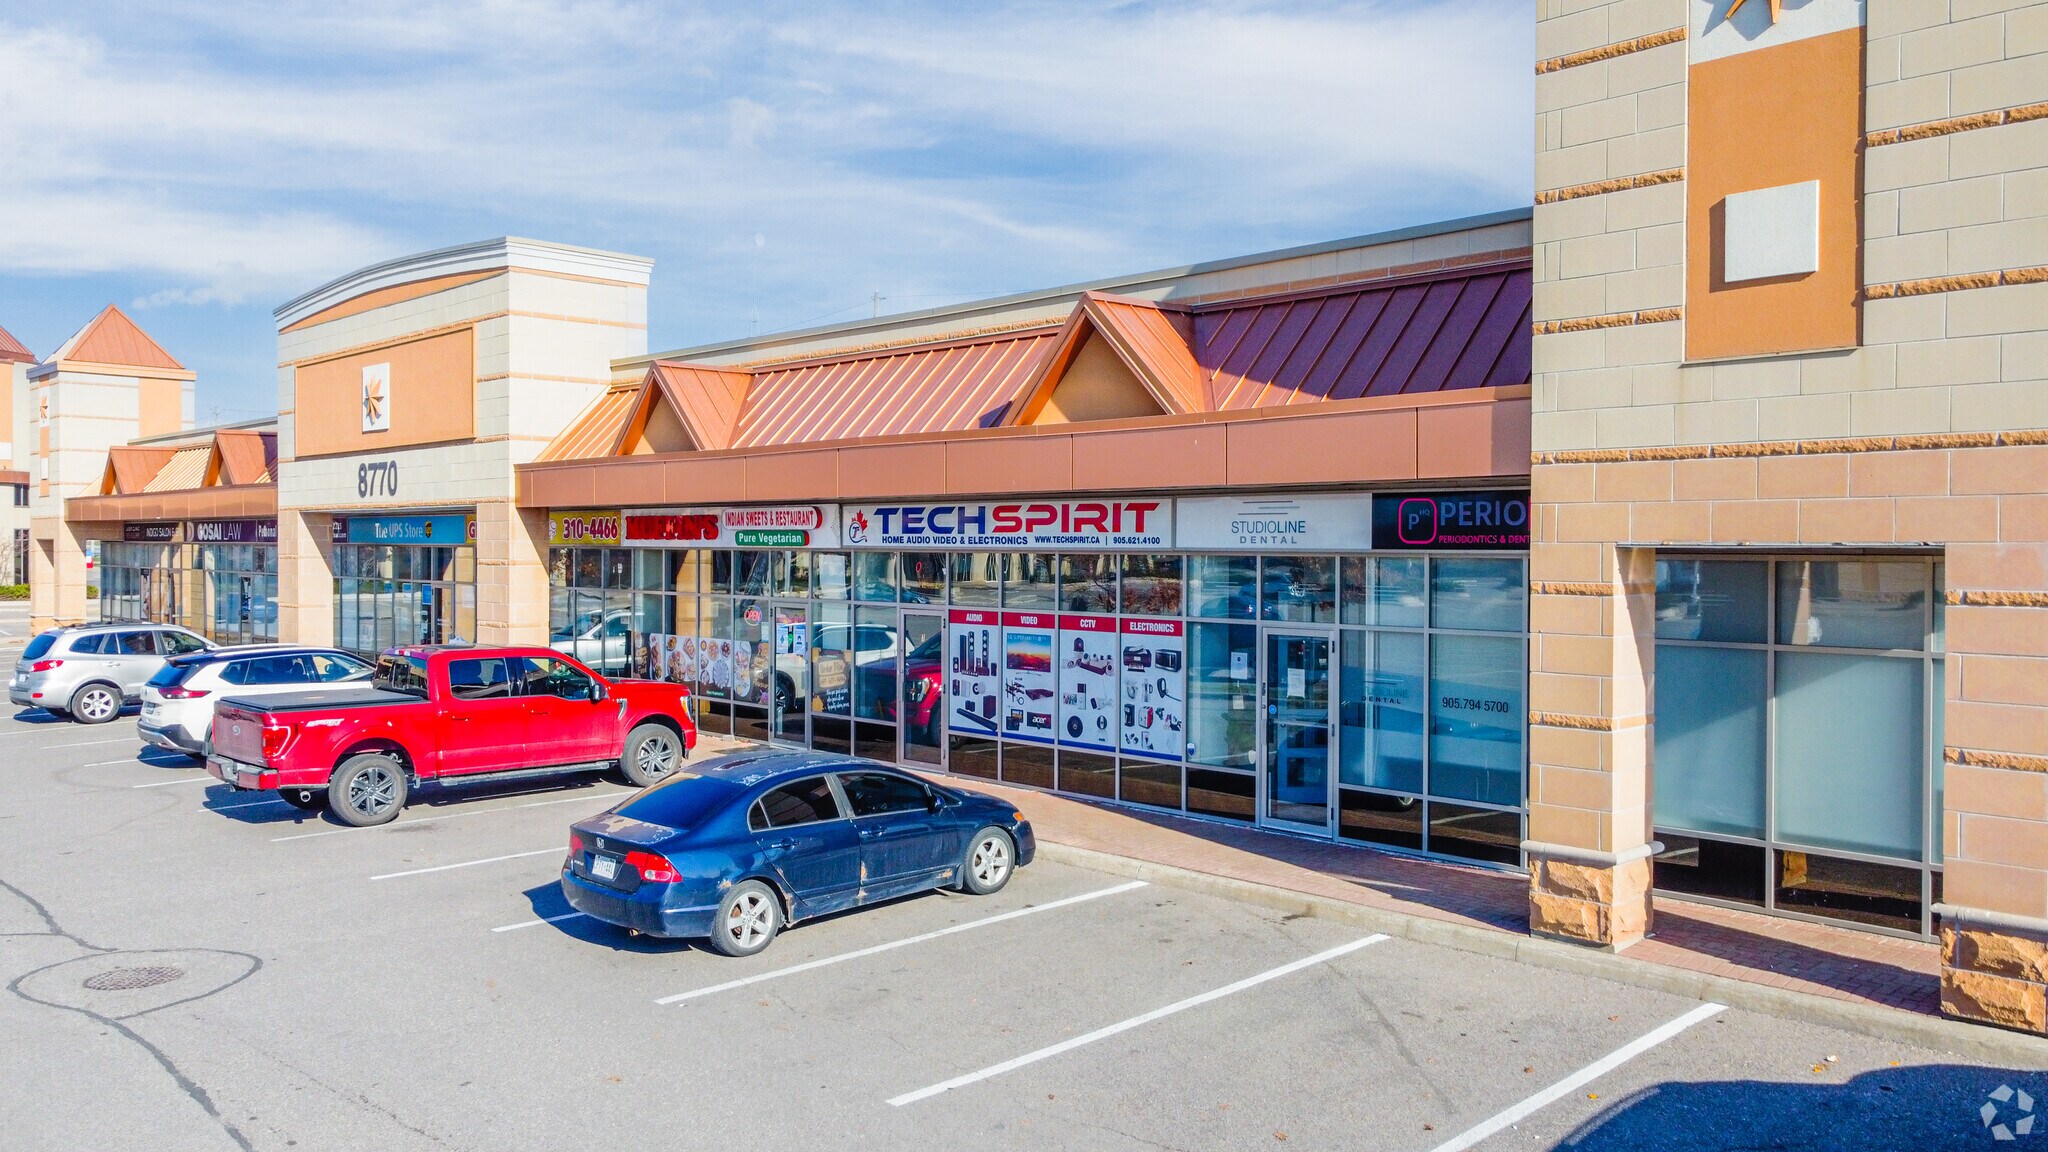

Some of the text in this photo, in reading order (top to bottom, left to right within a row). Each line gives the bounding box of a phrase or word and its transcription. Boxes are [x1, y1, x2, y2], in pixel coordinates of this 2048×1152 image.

[358, 460, 398, 498] 8770
[725, 510, 814, 526] INDIAN SWEETS & RESTAURANT
[1440, 500, 1530, 527] PERIO
[197, 523, 242, 540] GOSAI LAW
[389, 523, 403, 538] UPS
[405, 523, 423, 538] Store
[563, 517, 618, 539] 310-4466
[1231, 520, 1306, 534] STUDIOLINE
[739, 533, 802, 545] Pure Vegetarian
[882, 536, 1028, 545] HOME AUDIO VIDEO & ELECTRONICS
[1035, 535, 1160, 545] WWW.TECHSPIRIT.CA 905.621.4100
[1240, 535, 1298, 544] DENTAL
[1439, 535, 1498, 544] PERIODONTICS
[1500, 535, 1506, 544] &
[966, 613, 983, 623] AUDIO
[1020, 615, 1038, 625] VIDEO
[1080, 618, 1096, 629] CCTV
[1130, 621, 1174, 633] ELECTRONICS
[1442, 697, 1509, 713] 905.794 5700
[1032, 716, 1047, 724] acer
